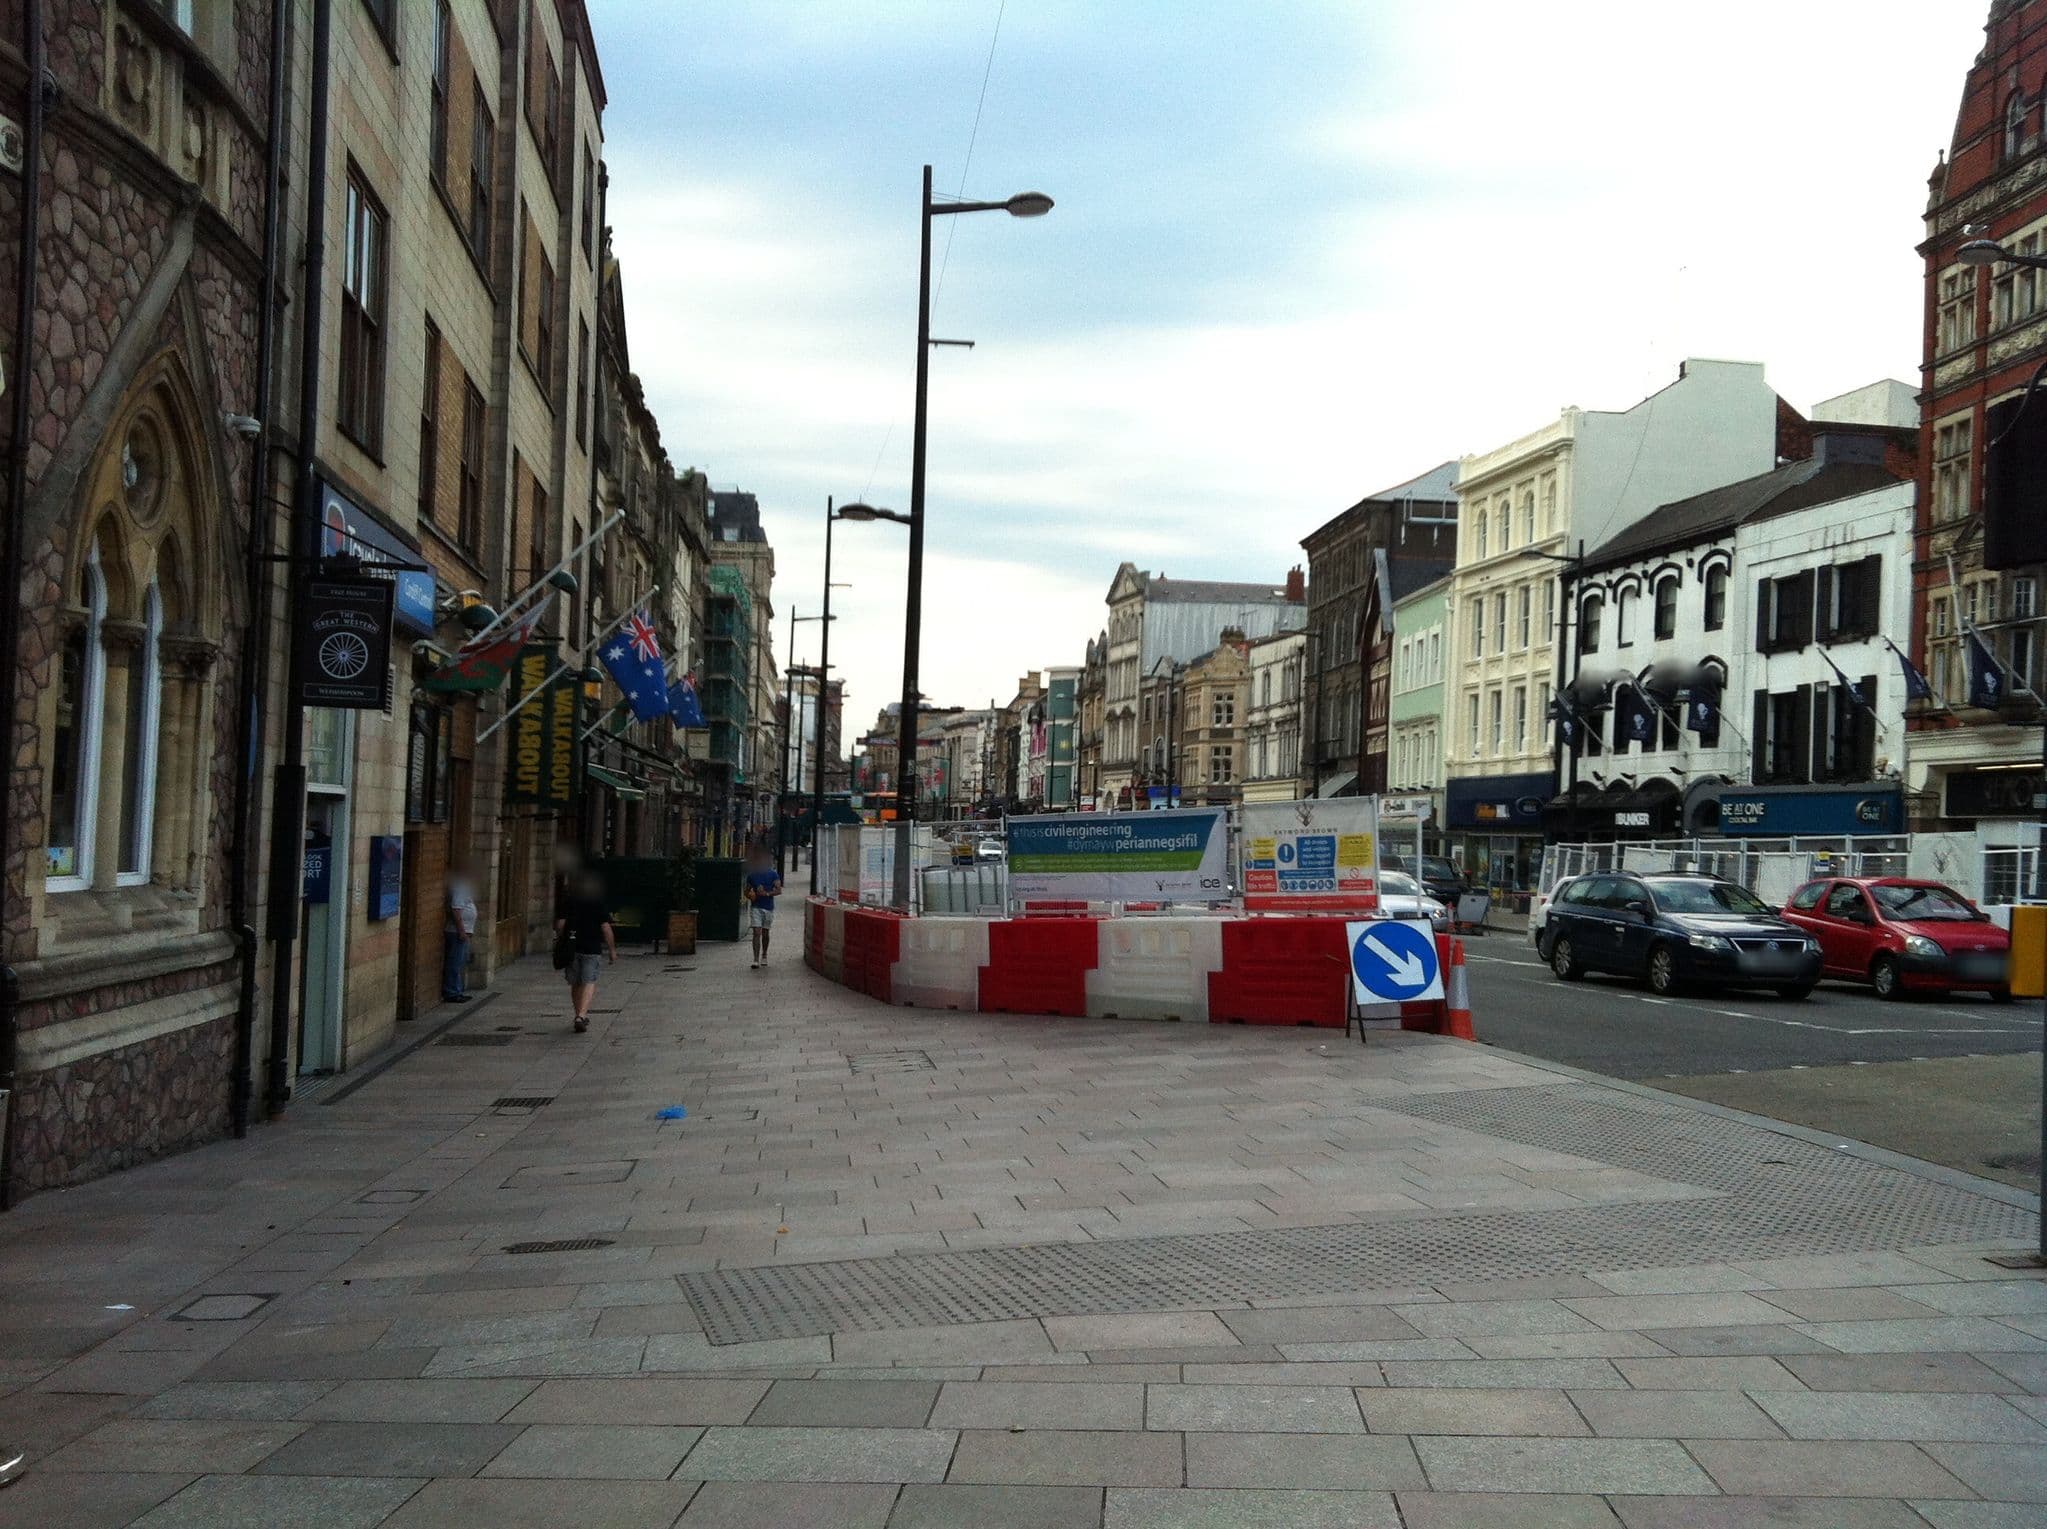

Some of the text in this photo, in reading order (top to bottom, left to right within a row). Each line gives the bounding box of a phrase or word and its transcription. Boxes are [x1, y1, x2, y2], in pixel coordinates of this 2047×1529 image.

[340, 611, 354, 619] THE
[314, 618, 378, 633] GREAT WESTERN
[516, 654, 547, 795] WALKABOUT
[551, 687, 575, 801] WALKABOUT
[1722, 803, 1733, 816] BE
[1744, 802, 1765, 815] ONE
[1862, 812, 1881, 821] ONE
[303, 853, 323, 861] OOK
